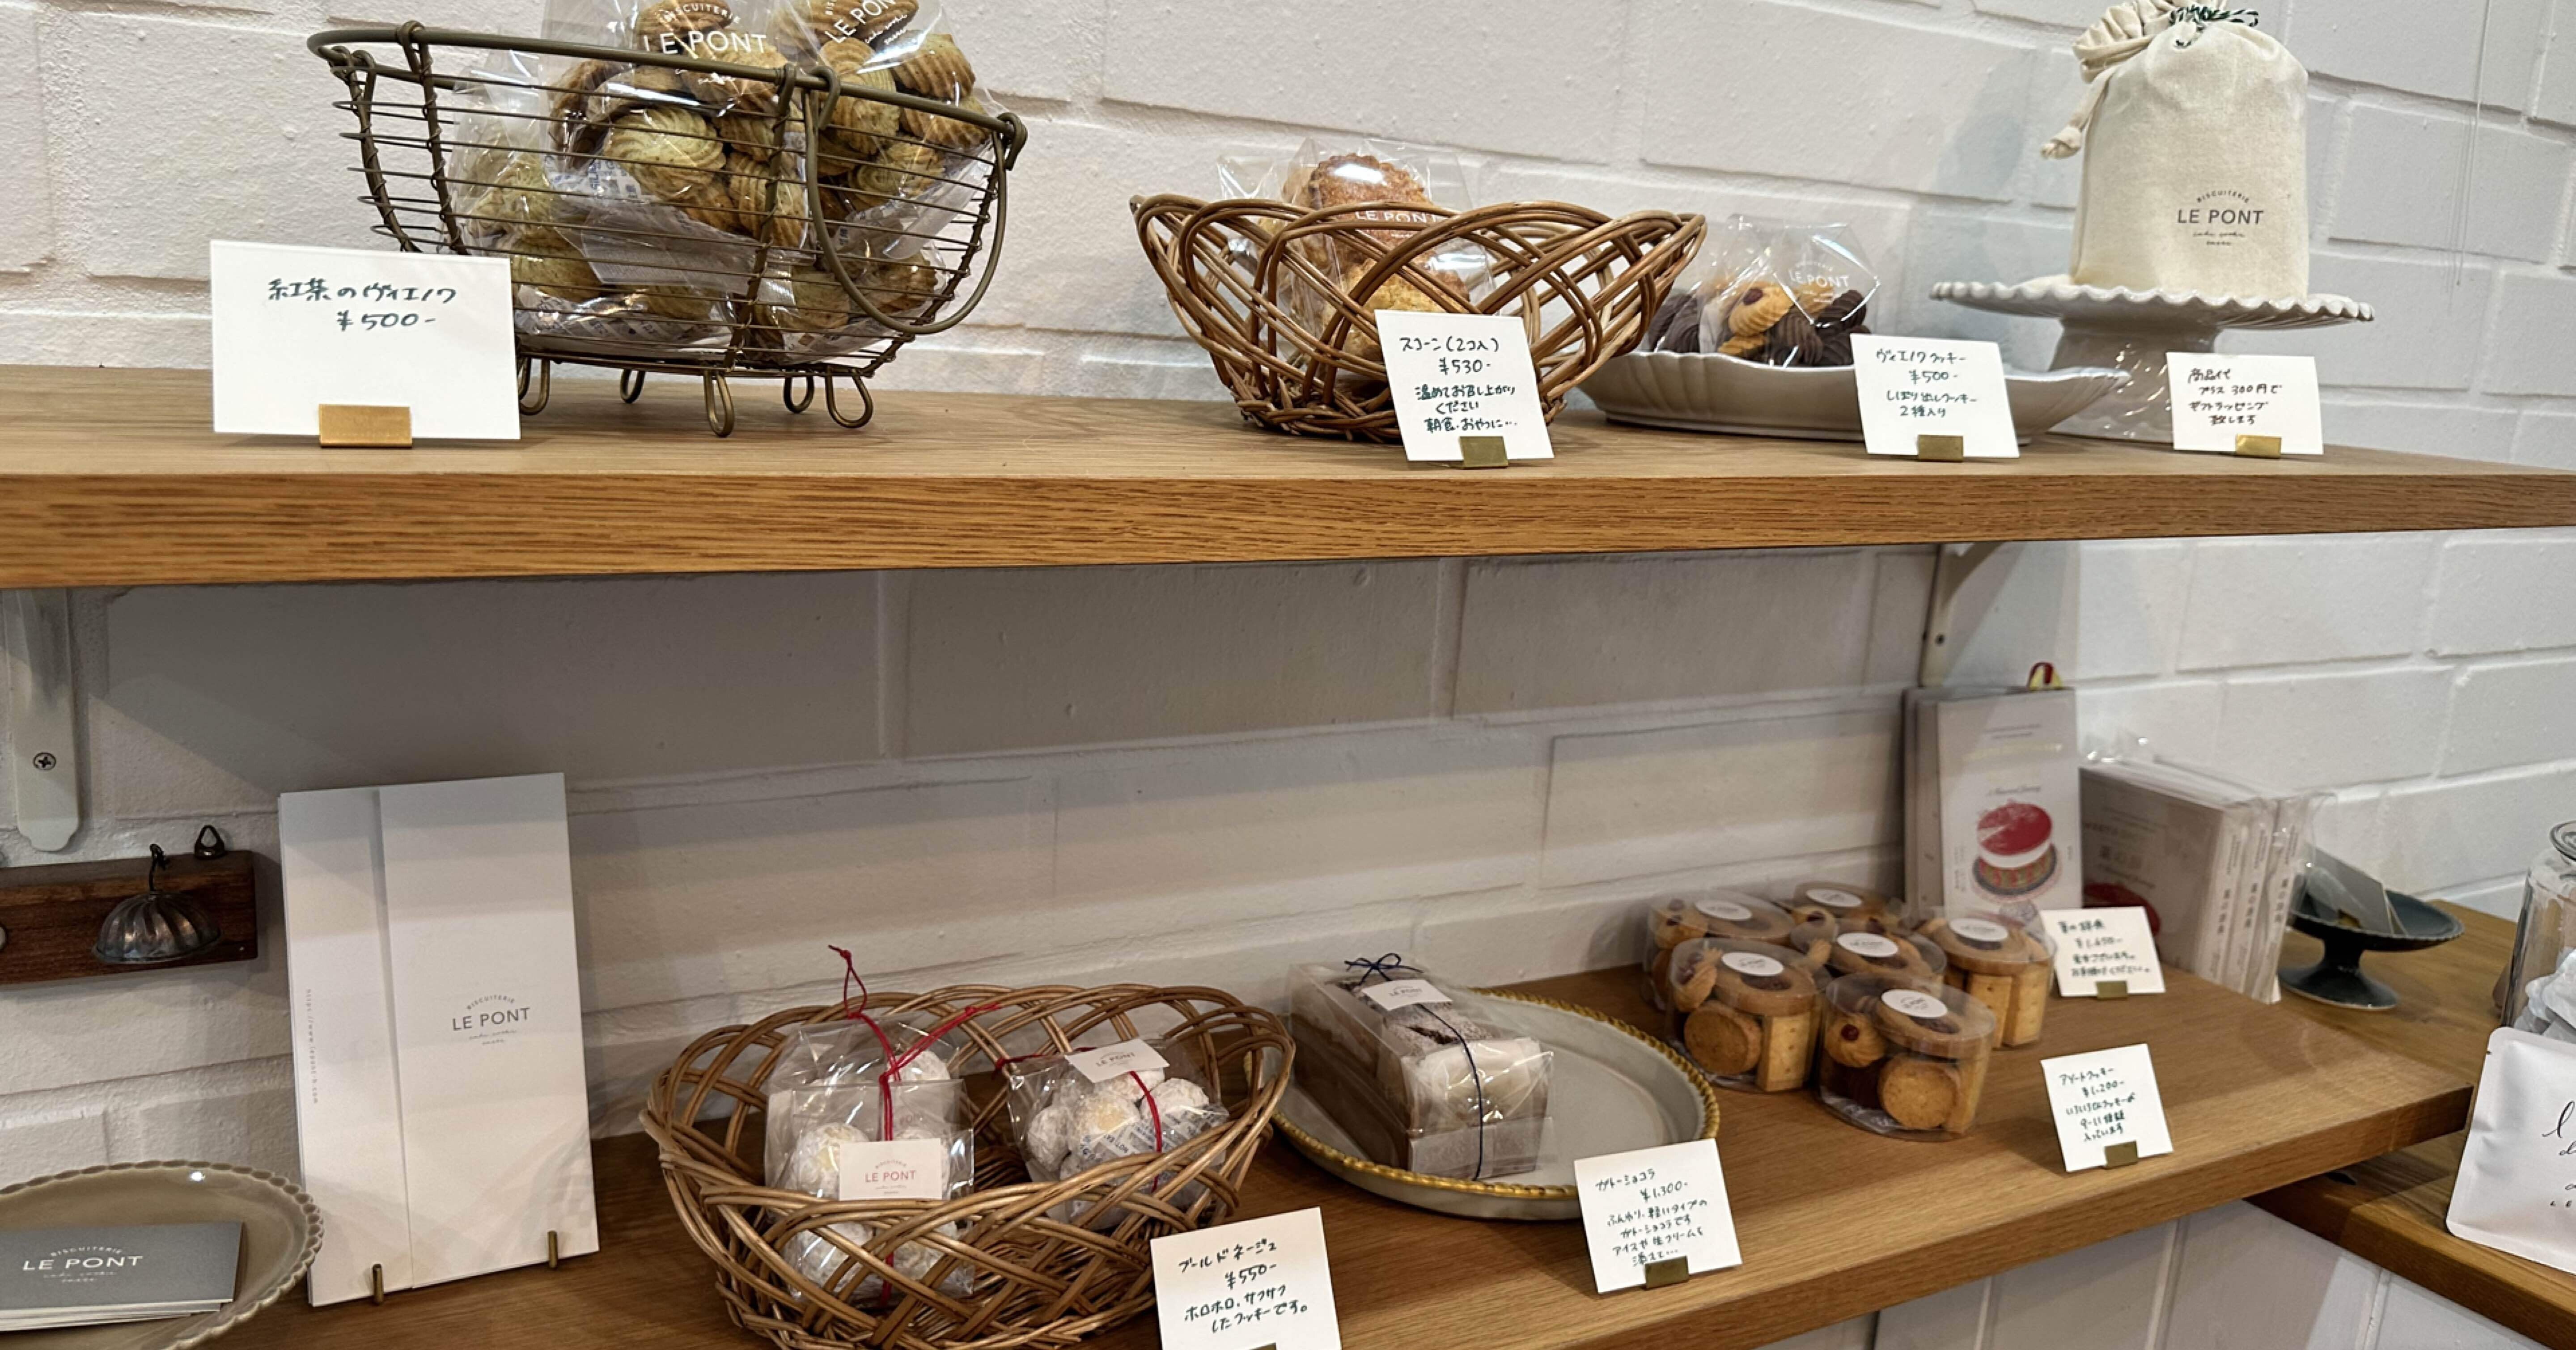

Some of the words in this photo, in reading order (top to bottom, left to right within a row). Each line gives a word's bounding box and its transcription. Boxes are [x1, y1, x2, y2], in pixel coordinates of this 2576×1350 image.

[825, 19, 856, 43] LE
[688, 30, 767, 53] PONT
[1355, 211, 1378, 221] LE
[2177, 209, 2200, 224] LE
[2208, 209, 2264, 224] PONT
[1807, 275, 1850, 288] PONT
[1435, 401, 1479, 415] ください
[452, 1016, 473, 1031] LE
[480, 1007, 531, 1028] PONT
[865, 1172, 879, 1183] LE
[883, 1170, 916, 1181] PONT
[23, 1259, 54, 1271] LE
[65, 1255, 143, 1269] PONT
